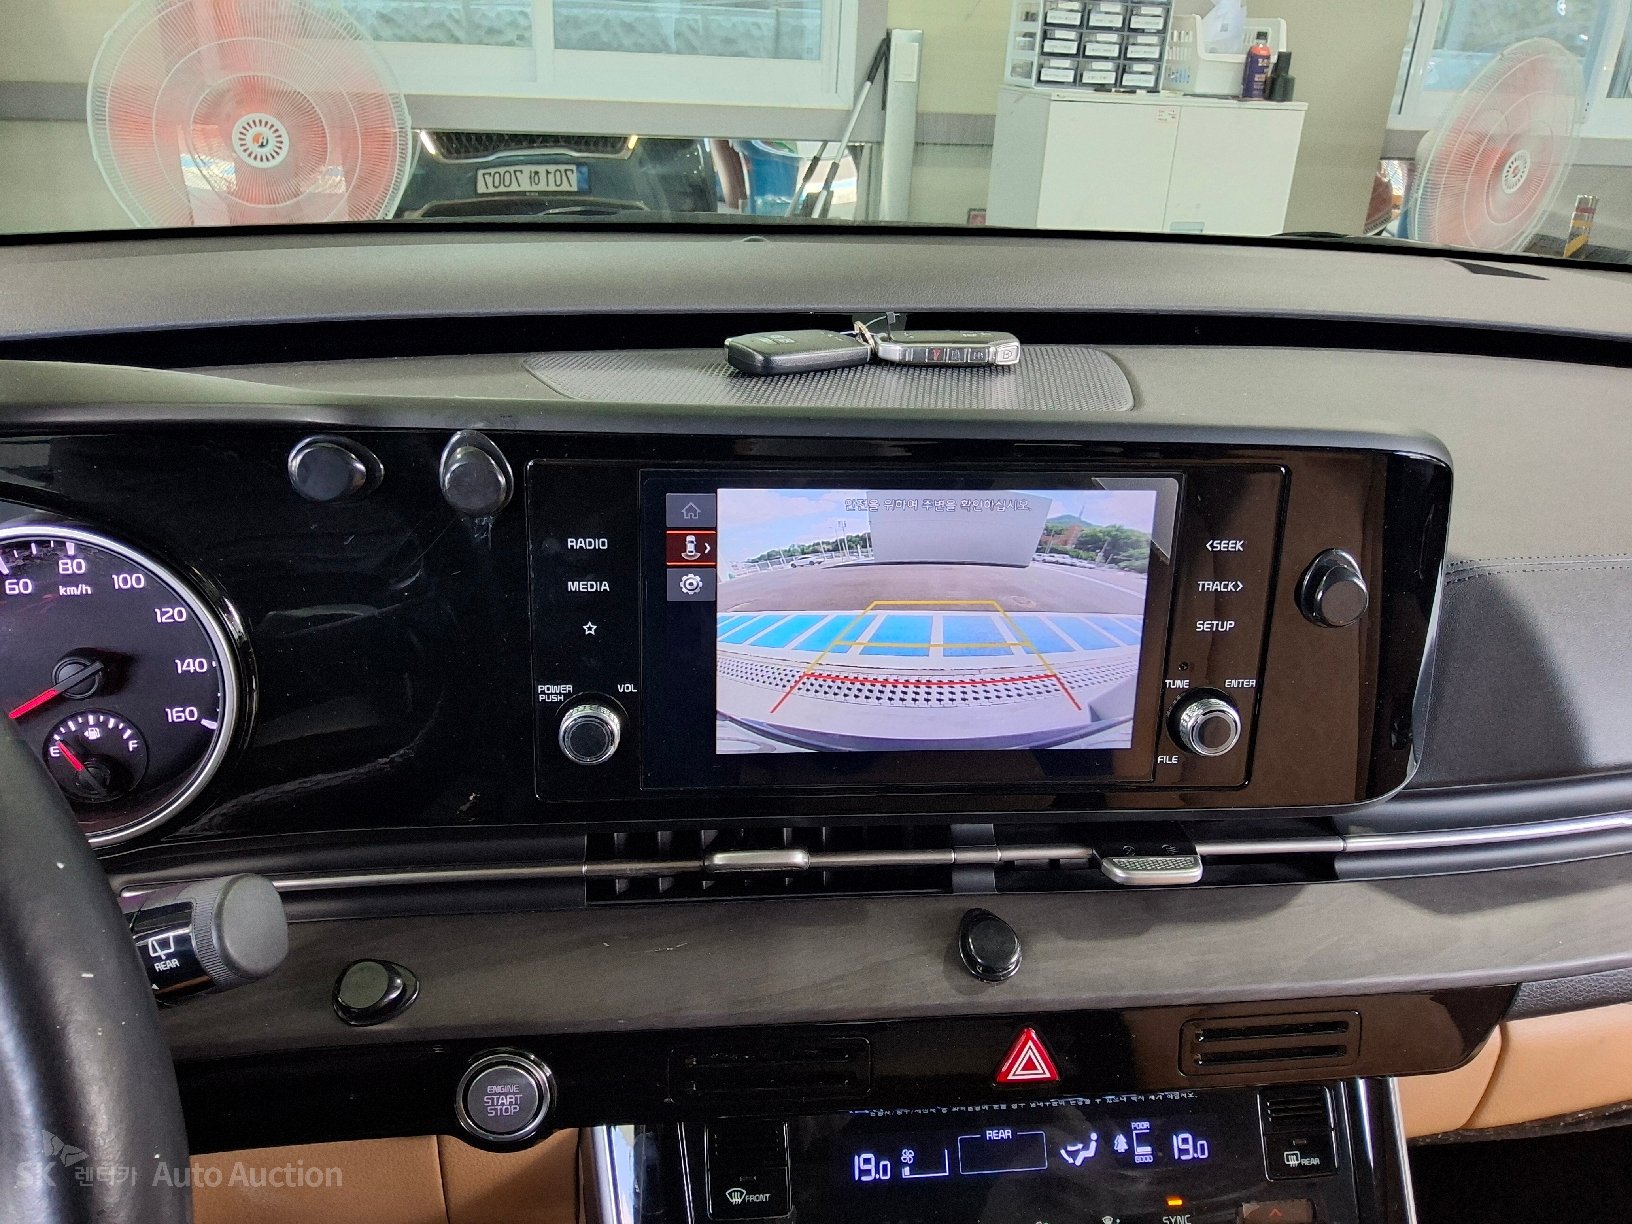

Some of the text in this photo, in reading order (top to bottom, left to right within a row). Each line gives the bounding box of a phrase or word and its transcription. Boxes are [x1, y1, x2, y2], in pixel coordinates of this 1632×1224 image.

[883, 498, 919, 512] 위하여
[921, 498, 957, 512] 주변을
[567, 538, 608, 550] RADIO
[58, 558, 86, 575] 80
[5, 579, 33, 595] 60
[112, 573, 146, 590] 100
[567, 581, 610, 592] MEDIA
[59, 583, 92, 597] km/h
[154, 606, 187, 624] 120
[1195, 620, 1236, 632] SETUP
[175, 657, 208, 674] 140
[537, 684, 573, 694] POWER
[617, 683, 638, 693] VOL
[1165, 679, 1190, 689] TUNE
[1225, 679, 1257, 689] ENTER
[538, 694, 564, 703] PUSH
[166, 706, 199, 723] 160
[50, 746, 60, 758] E
[128, 740, 139, 752] F
[1157, 755, 1179, 765] FILE
[154, 958, 180, 973] REAR
[487, 1084, 520, 1094] ENGINE
[484, 1094, 523, 1106] START
[487, 1105, 520, 1117] STOP
[1131, 1121, 1151, 1131] POOR
[986, 1129, 1013, 1141] REAR
[1172, 1132, 1209, 1161] 19.0
[1134, 1154, 1154, 1164] GOOD
[1300, 1157, 1321, 1166] REAR
[853, 1152, 891, 1182] 19.0
[746, 1193, 771, 1203] FRONT
